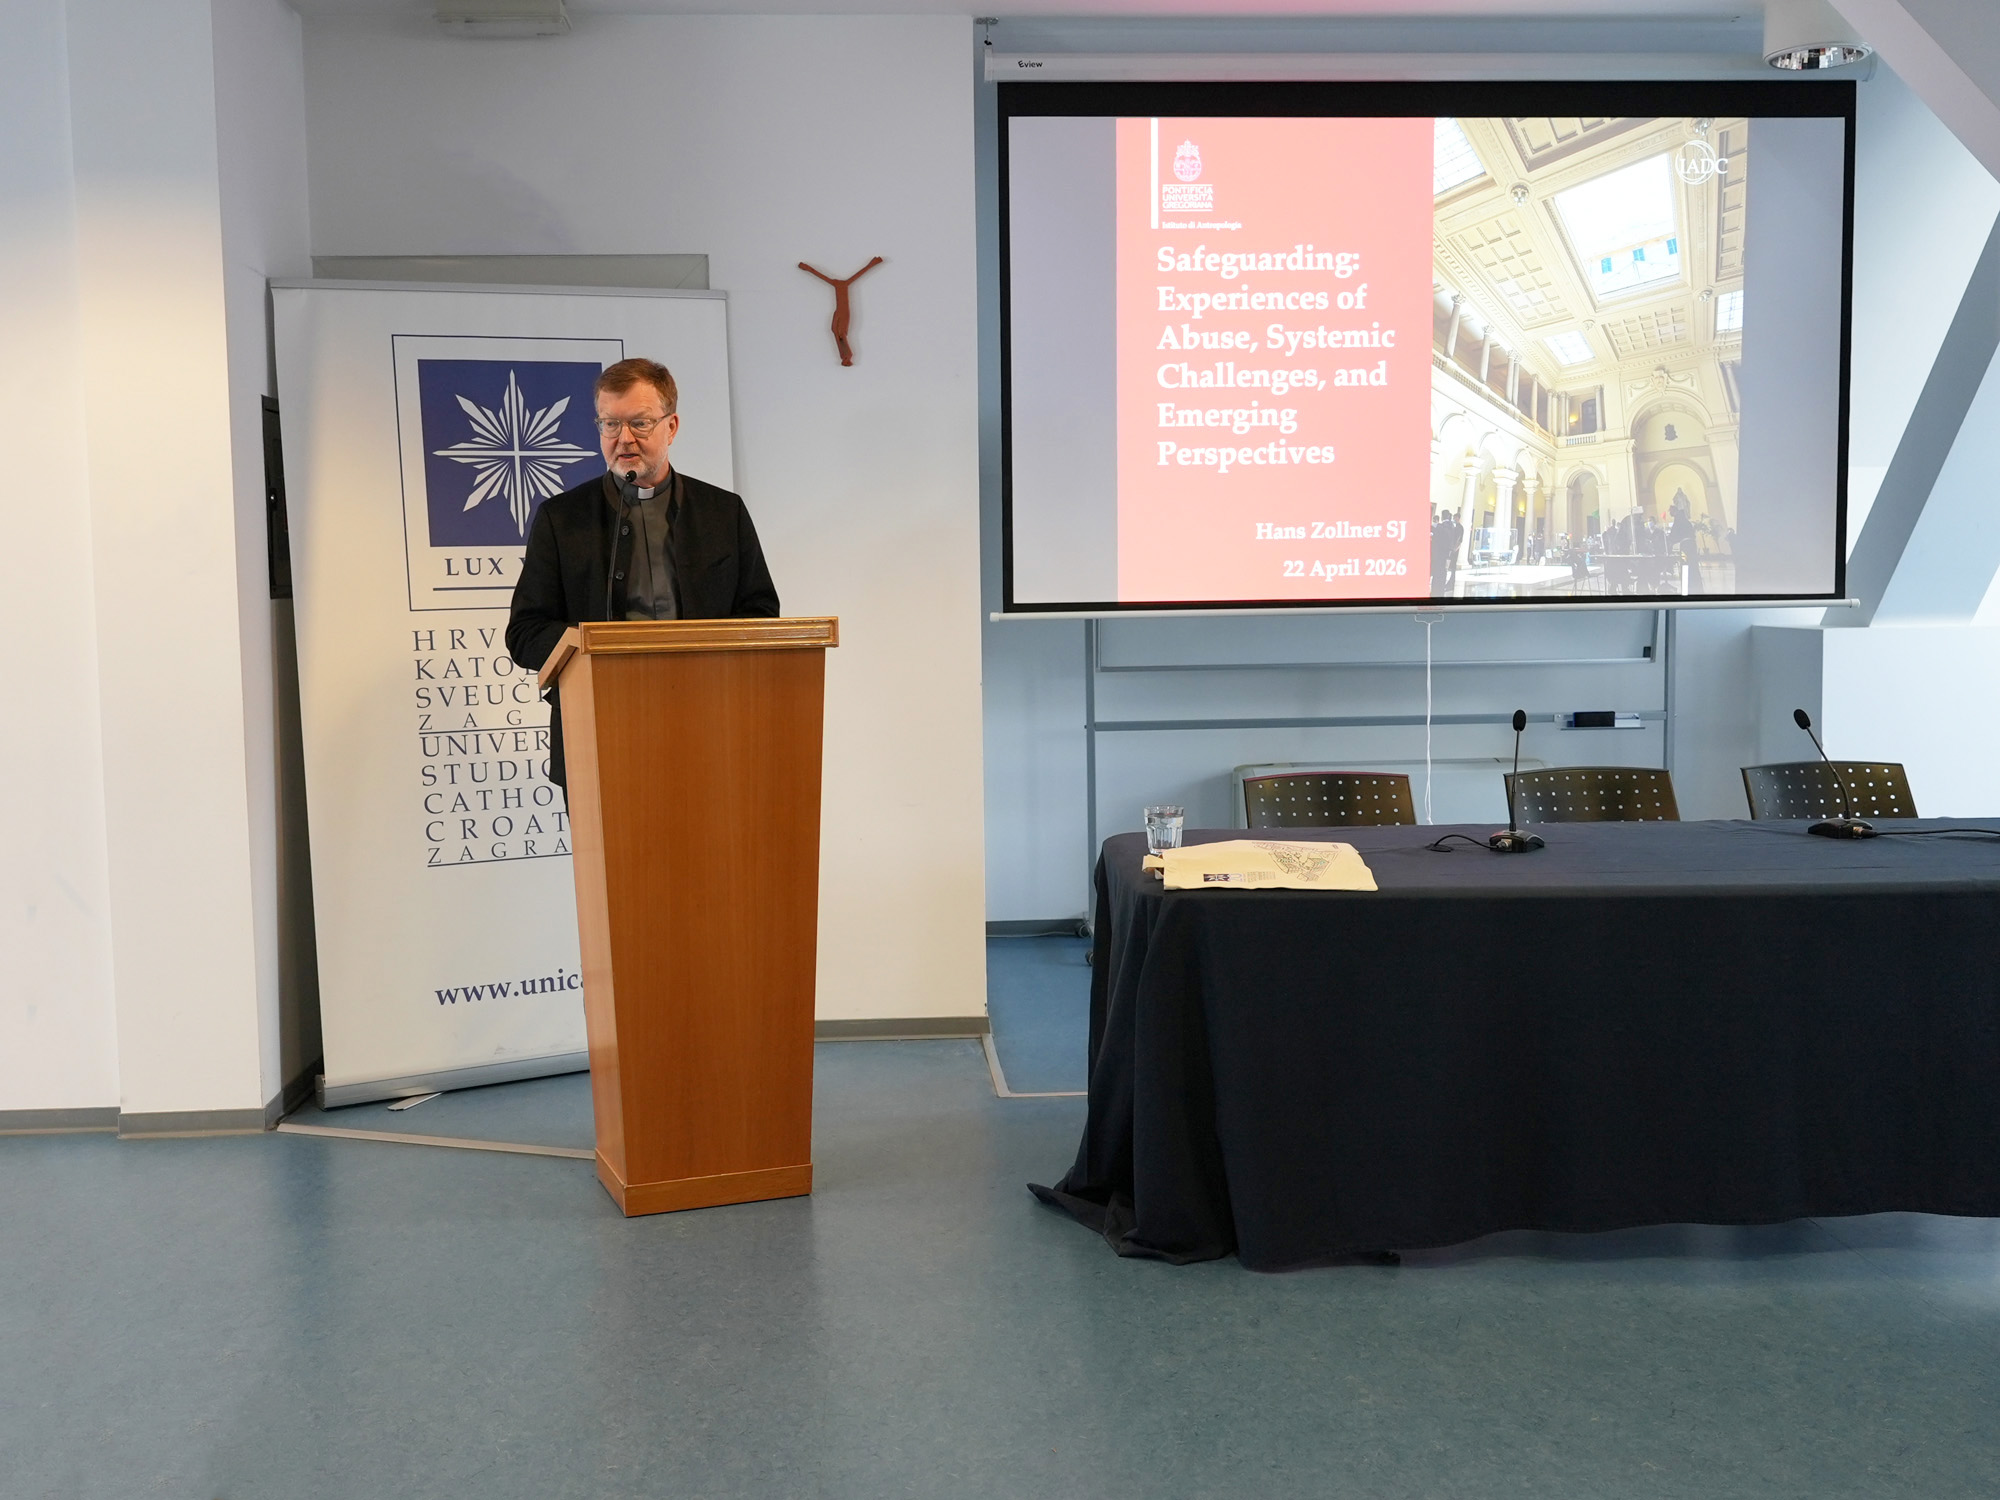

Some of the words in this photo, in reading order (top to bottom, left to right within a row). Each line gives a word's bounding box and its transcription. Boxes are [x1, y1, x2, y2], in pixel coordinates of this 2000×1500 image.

[1018, 60, 1043, 68] Eview
[1680, 158, 1728, 174] IADC
[1162, 186, 1213, 194] PONTIFICIA
[1162, 201, 1213, 209] GREGORIANA
[1157, 244, 1360, 279] Safeguarding:
[1156, 284, 1329, 319] Experiences
[1336, 283, 1368, 309] of
[1156, 323, 1259, 353] Abuse,
[1266, 321, 1396, 356] Systemic
[1156, 361, 1327, 396] Challenges,
[1333, 360, 1388, 387] and
[1157, 400, 1298, 434] Emerging
[1157, 438, 1336, 473] Perspectives
[1255, 522, 1306, 540] Hans
[1310, 521, 1382, 539] Zollner
[1386, 520, 1407, 542] SJ
[444, 557, 504, 576] LUX
[1283, 560, 1305, 577] 22
[1308, 558, 1360, 582] April
[1364, 558, 1407, 576] 2026
[420, 730, 551, 758] UNIVER
[424, 785, 554, 815] CATHO
[425, 811, 568, 842] CROAT
[428, 837, 569, 864] ZAGRA
